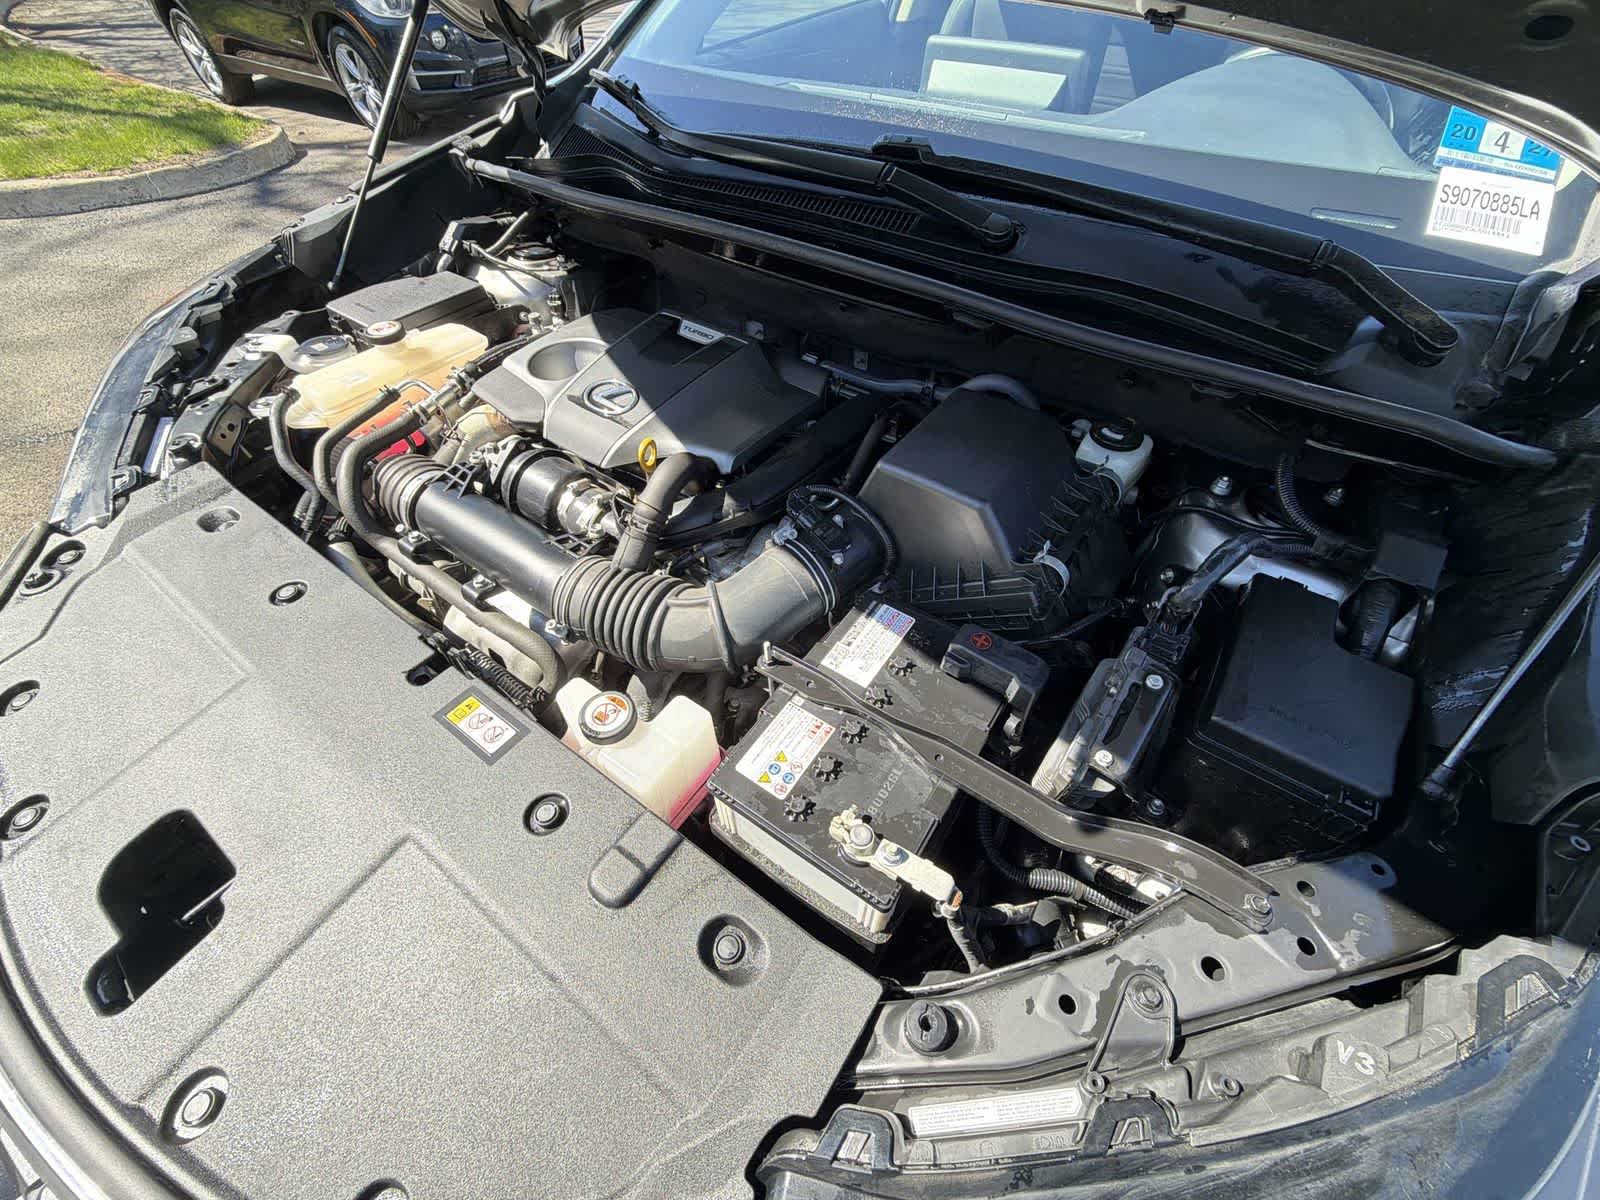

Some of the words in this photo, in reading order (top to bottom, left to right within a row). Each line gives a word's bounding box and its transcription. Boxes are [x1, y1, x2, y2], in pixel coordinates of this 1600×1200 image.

[1451, 123, 1477, 141] 20
[1494, 131, 1510, 154] 4
[1439, 183, 1541, 221] S9070885LA
[682, 323, 715, 340] TURBO
